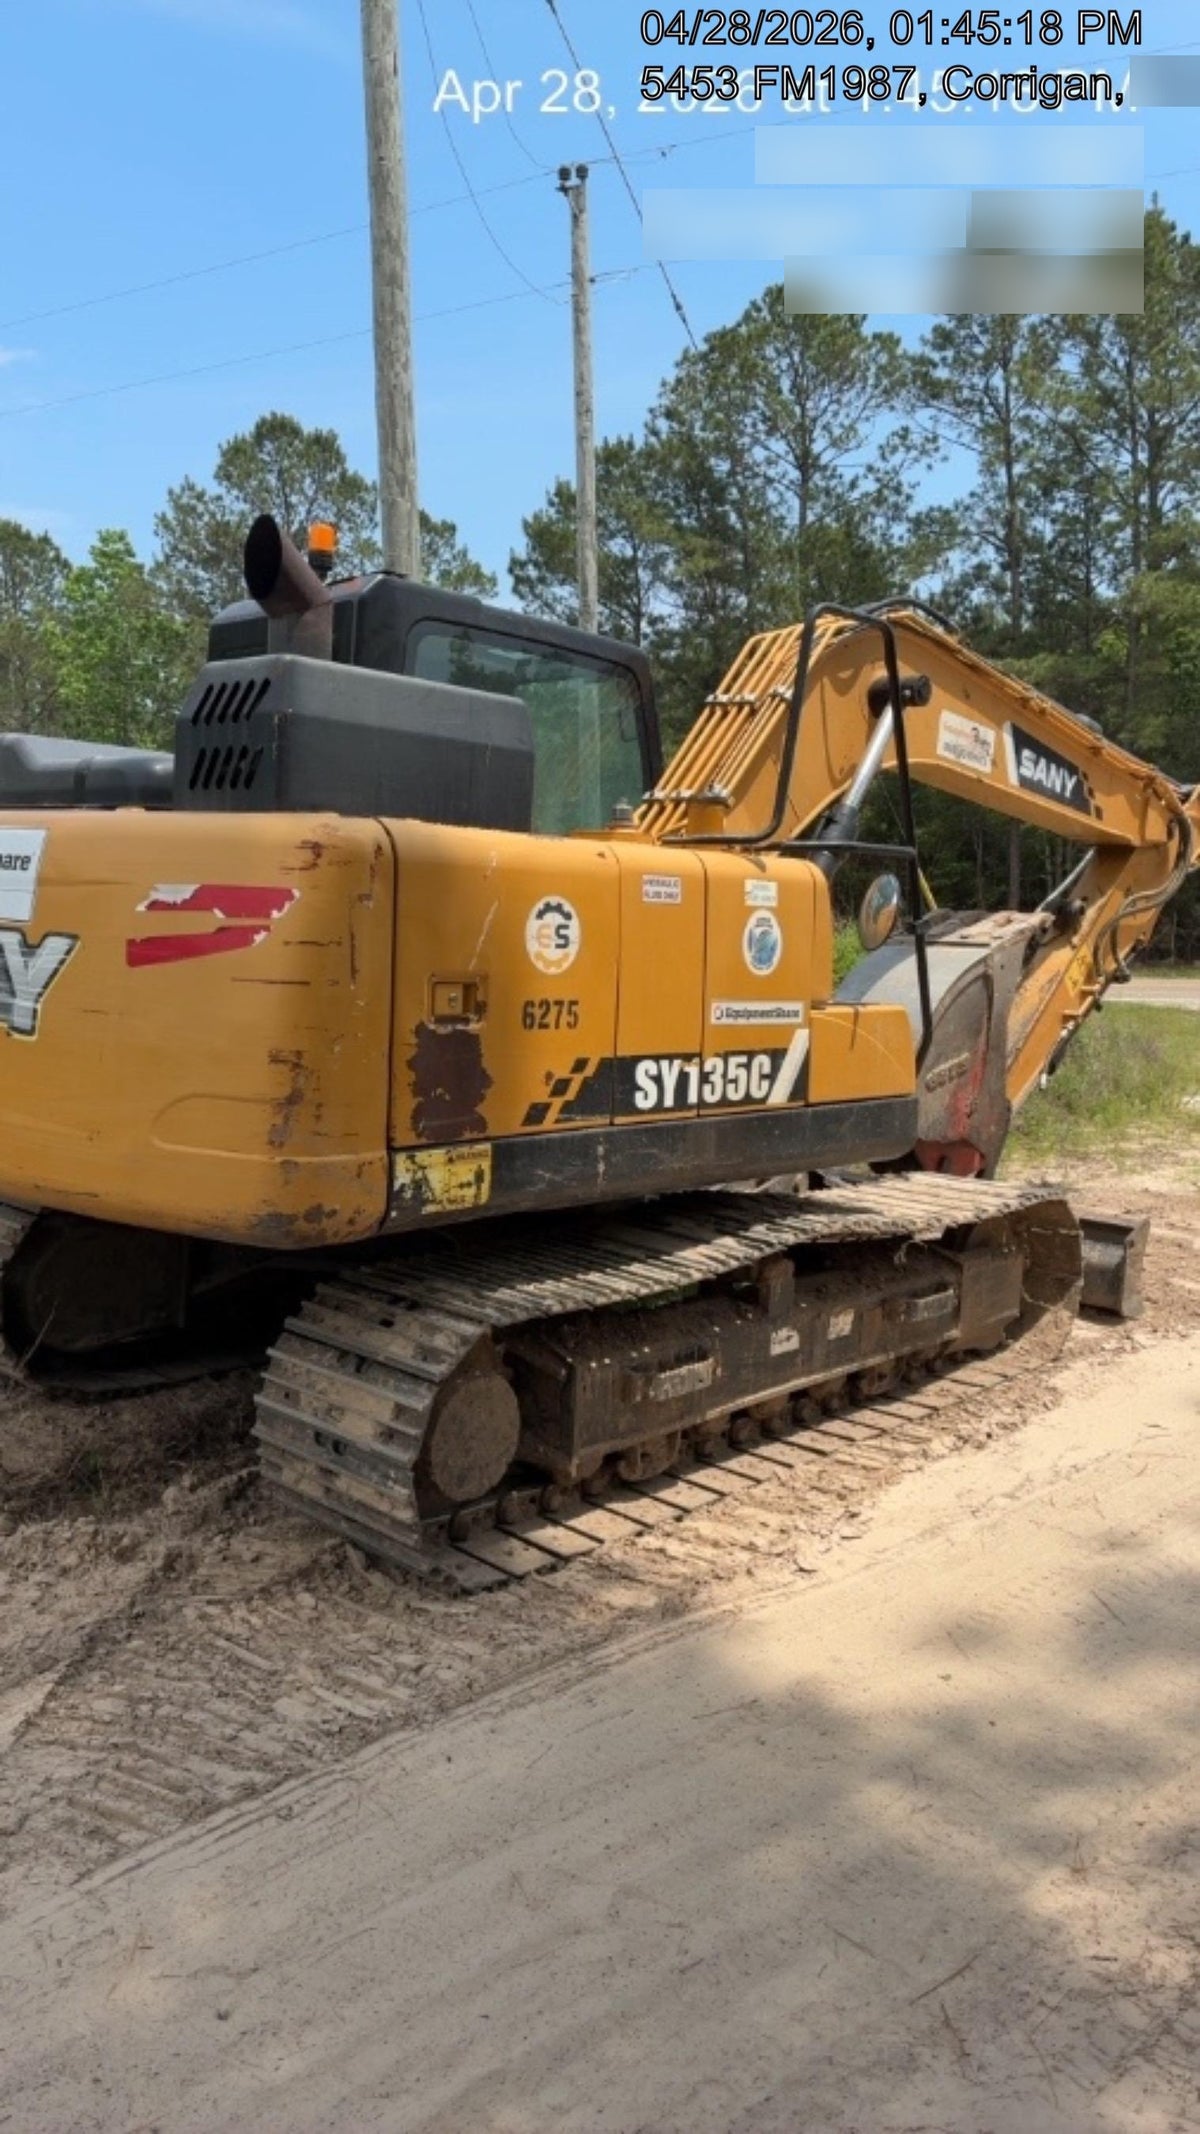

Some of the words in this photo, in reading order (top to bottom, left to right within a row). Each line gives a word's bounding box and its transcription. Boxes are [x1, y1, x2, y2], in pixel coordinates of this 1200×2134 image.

[1018, 748, 1078, 799] SANY
[0, 852, 32, 871] are
[521, 998, 580, 1031] 6275
[634, 1053, 772, 1111] SY135C
